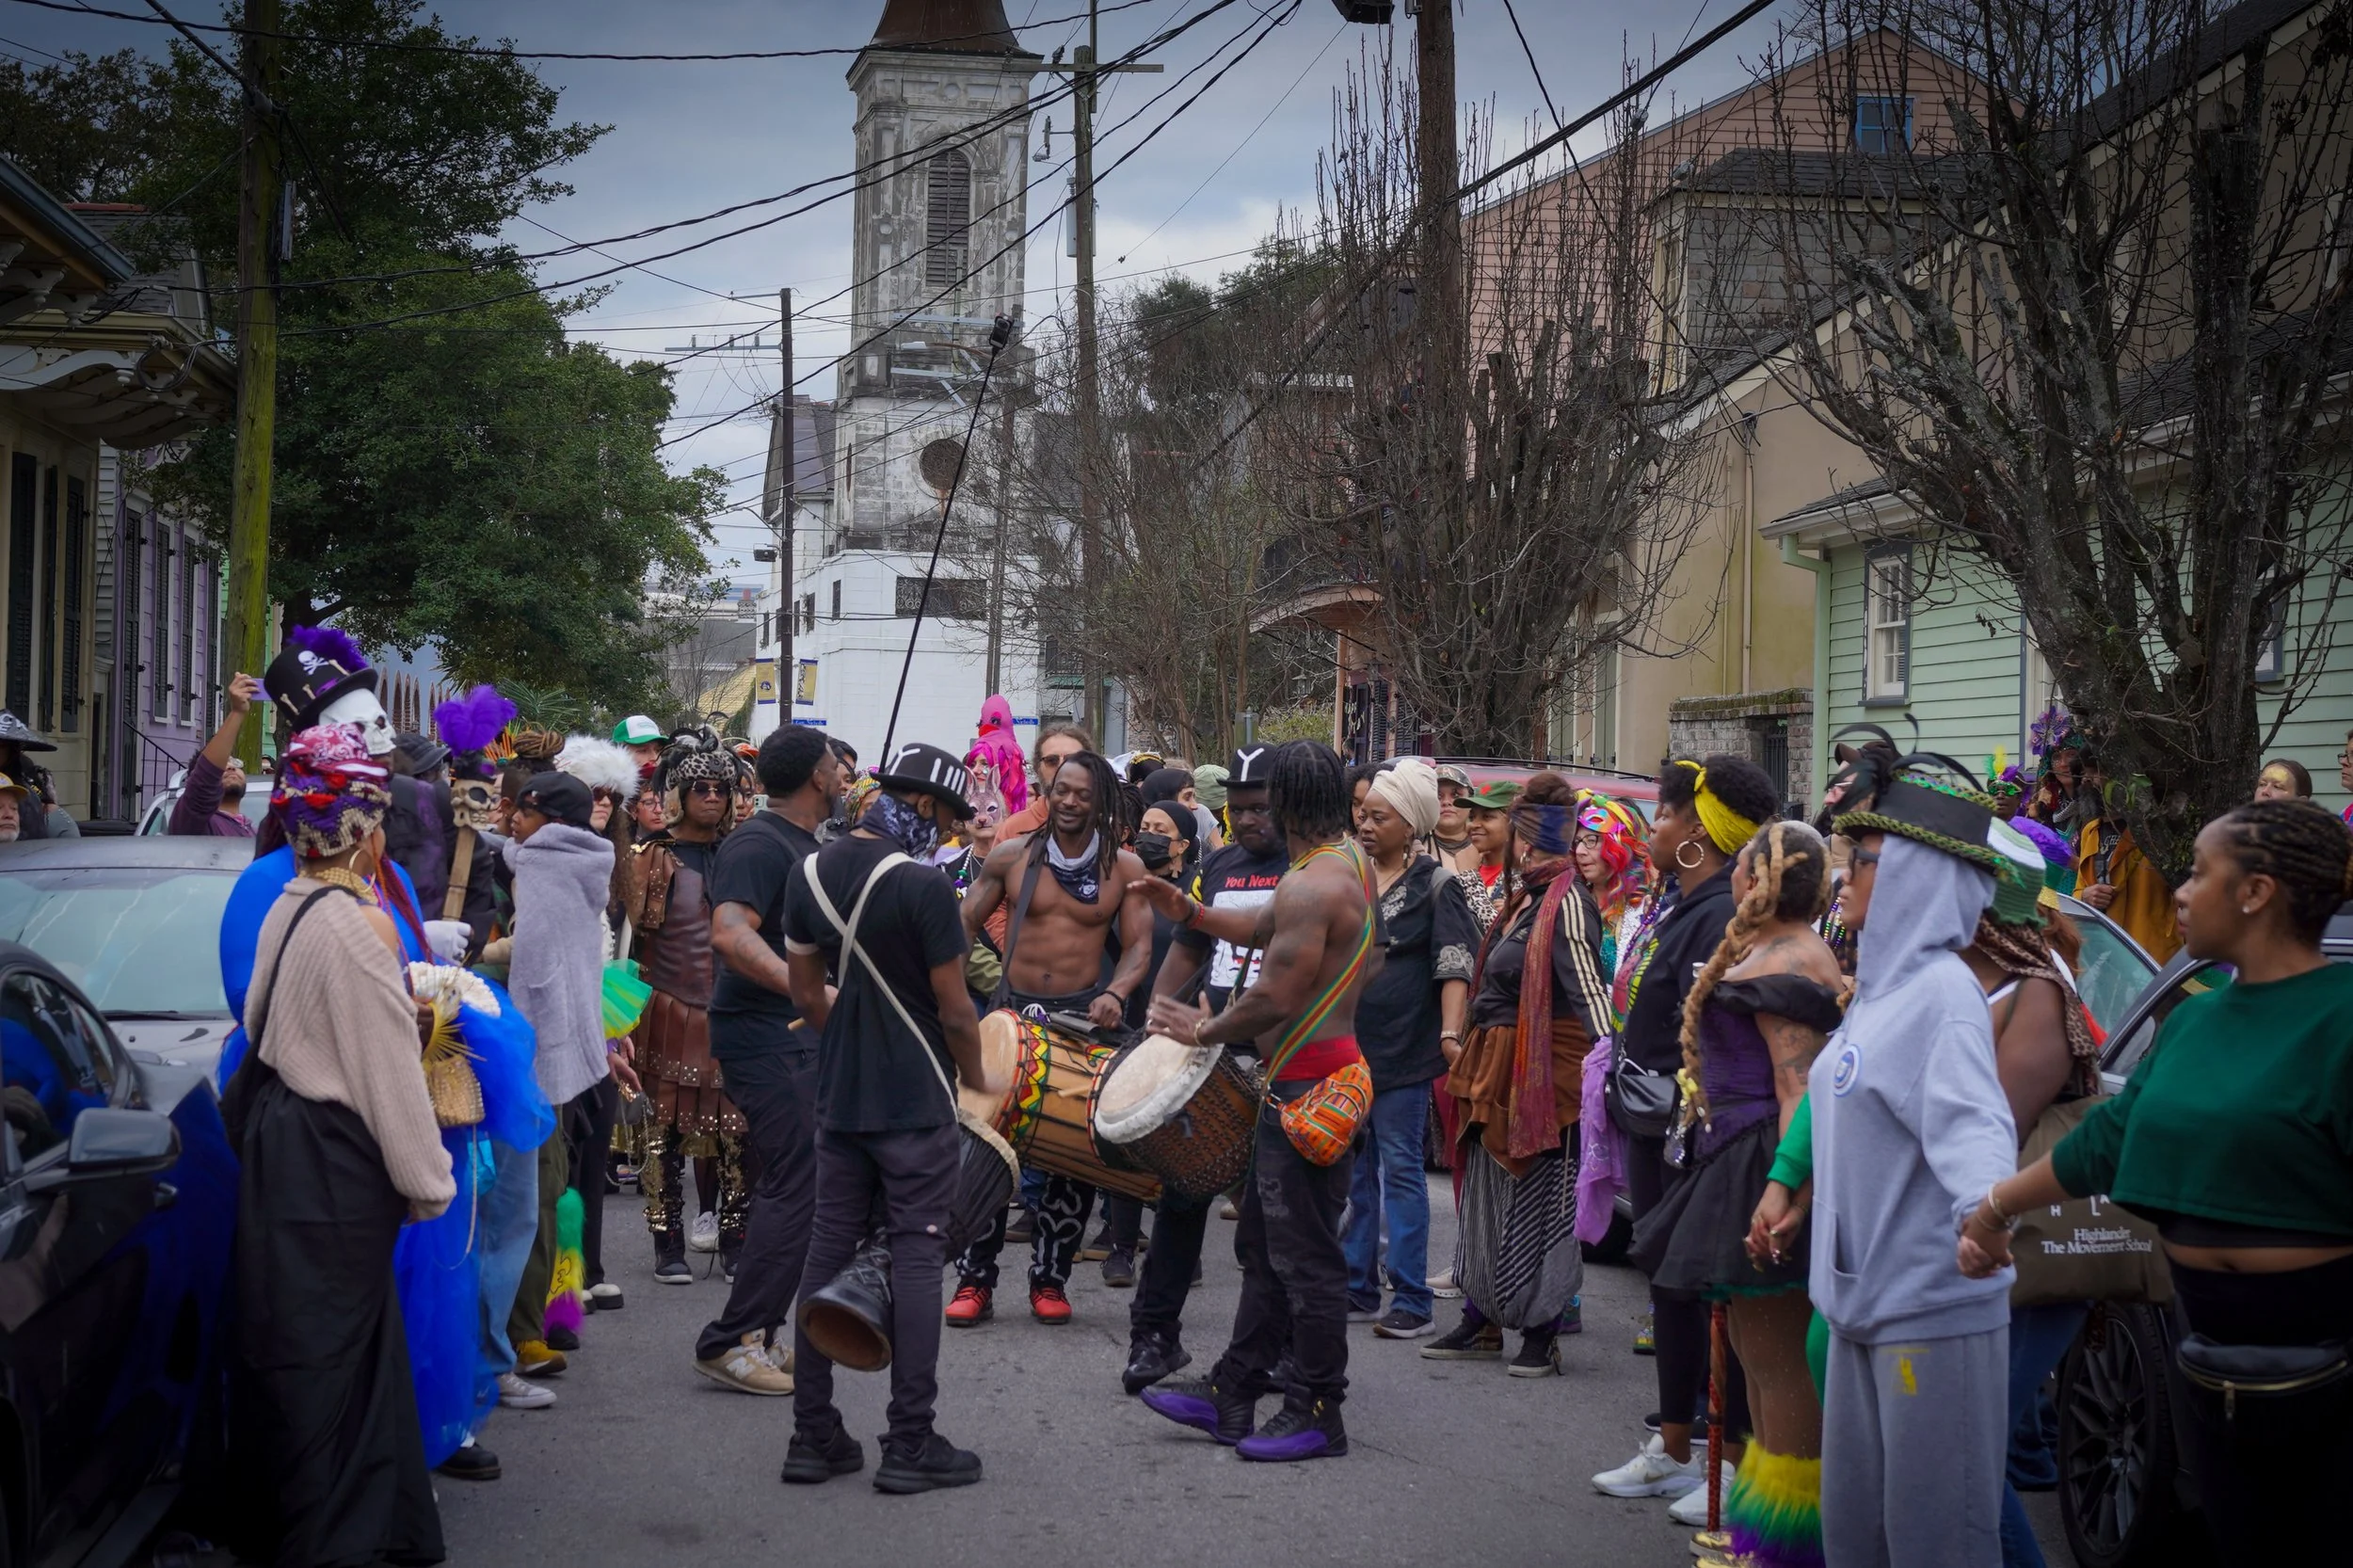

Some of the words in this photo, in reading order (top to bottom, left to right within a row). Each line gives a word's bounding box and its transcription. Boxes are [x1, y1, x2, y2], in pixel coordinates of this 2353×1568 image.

[1225, 876, 1246, 888] You
[2073, 1226, 2131, 1242] Highlander
[2041, 1240, 2065, 1254] The
[2067, 1240, 2125, 1254] Movement
[2125, 1239, 2153, 1253] School
